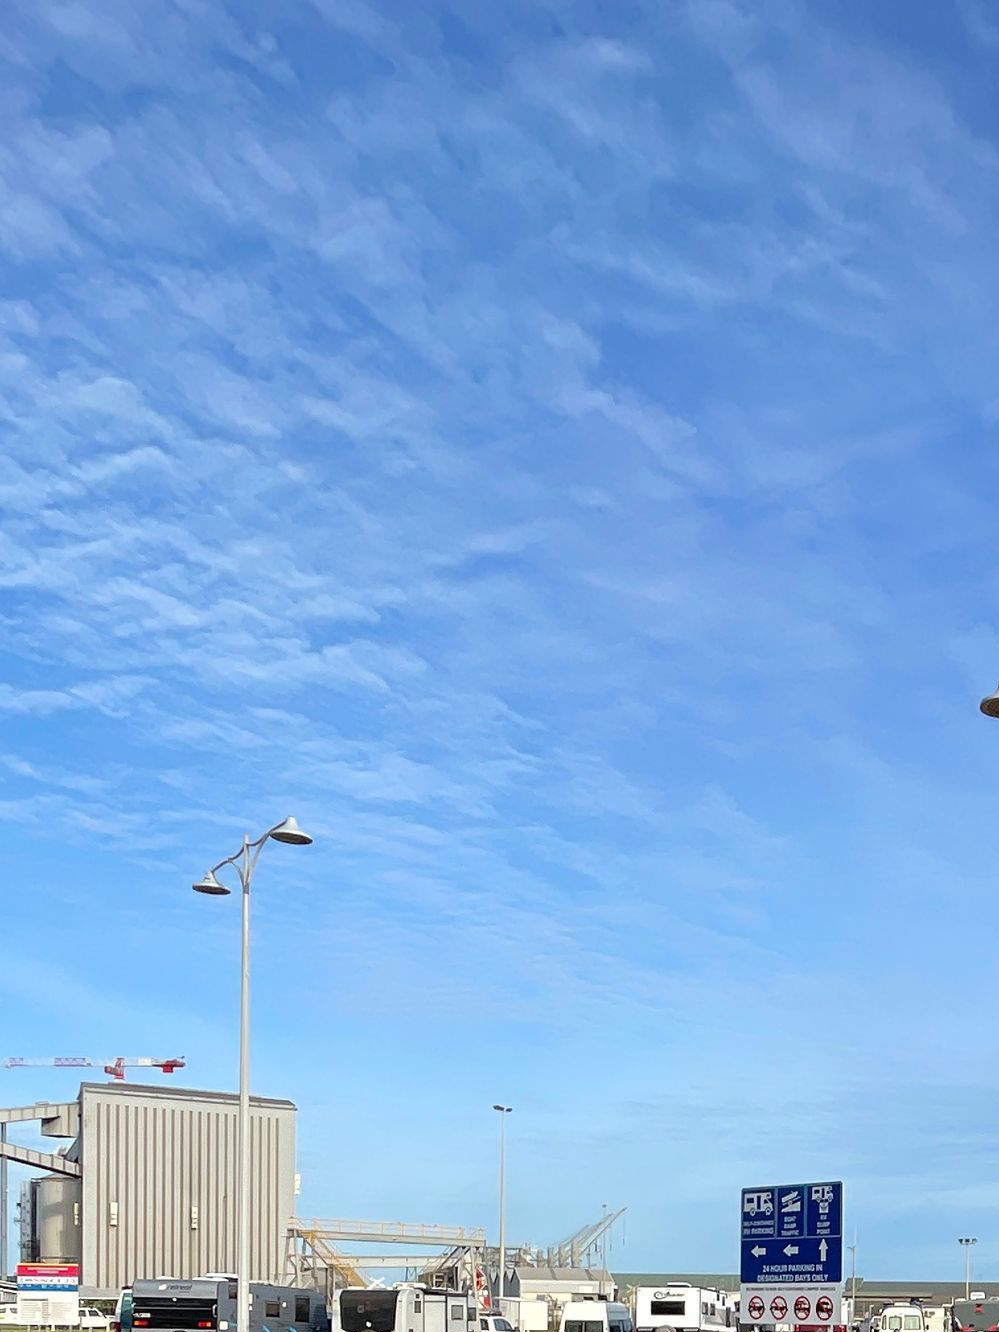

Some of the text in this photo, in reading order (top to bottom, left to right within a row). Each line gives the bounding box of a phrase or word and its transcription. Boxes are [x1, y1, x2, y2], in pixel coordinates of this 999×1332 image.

[770, 1264, 787, 1272] HOUR
[788, 1264, 815, 1272] PARKING
[757, 1274, 794, 1282] DESIGNATED
[794, 1274, 811, 1282] BAYS
